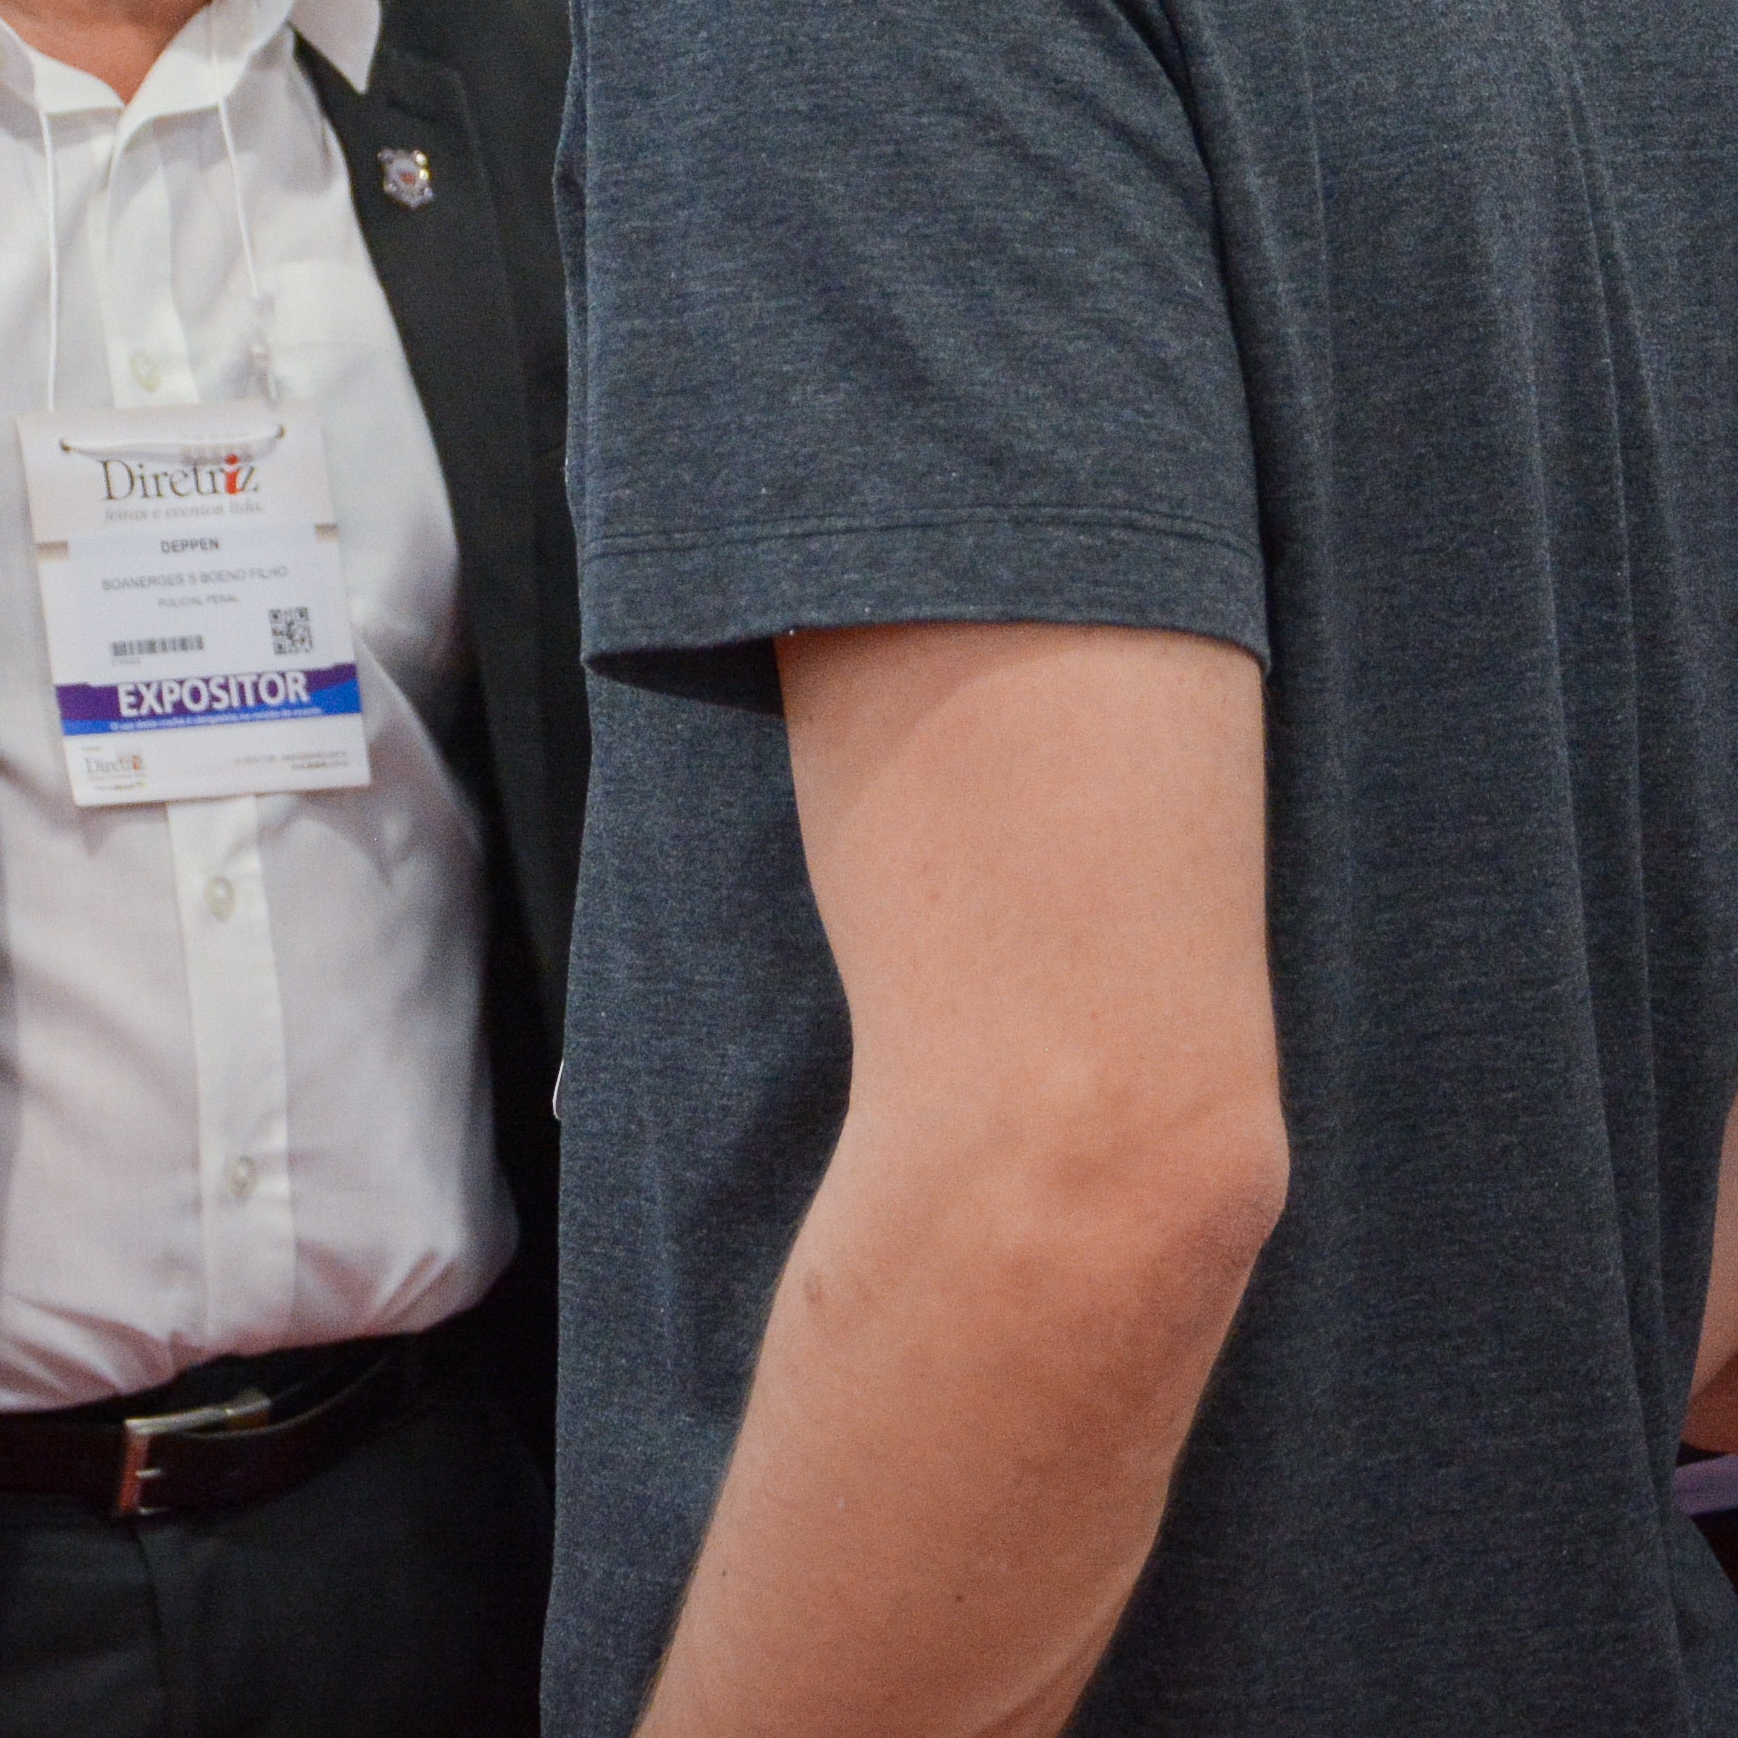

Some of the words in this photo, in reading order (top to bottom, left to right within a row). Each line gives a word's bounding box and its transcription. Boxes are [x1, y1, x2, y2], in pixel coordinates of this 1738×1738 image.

[100, 453, 260, 501] Diretriz
[160, 537, 221, 553] DEPPEN
[116, 670, 312, 718] EXPOSITOR
